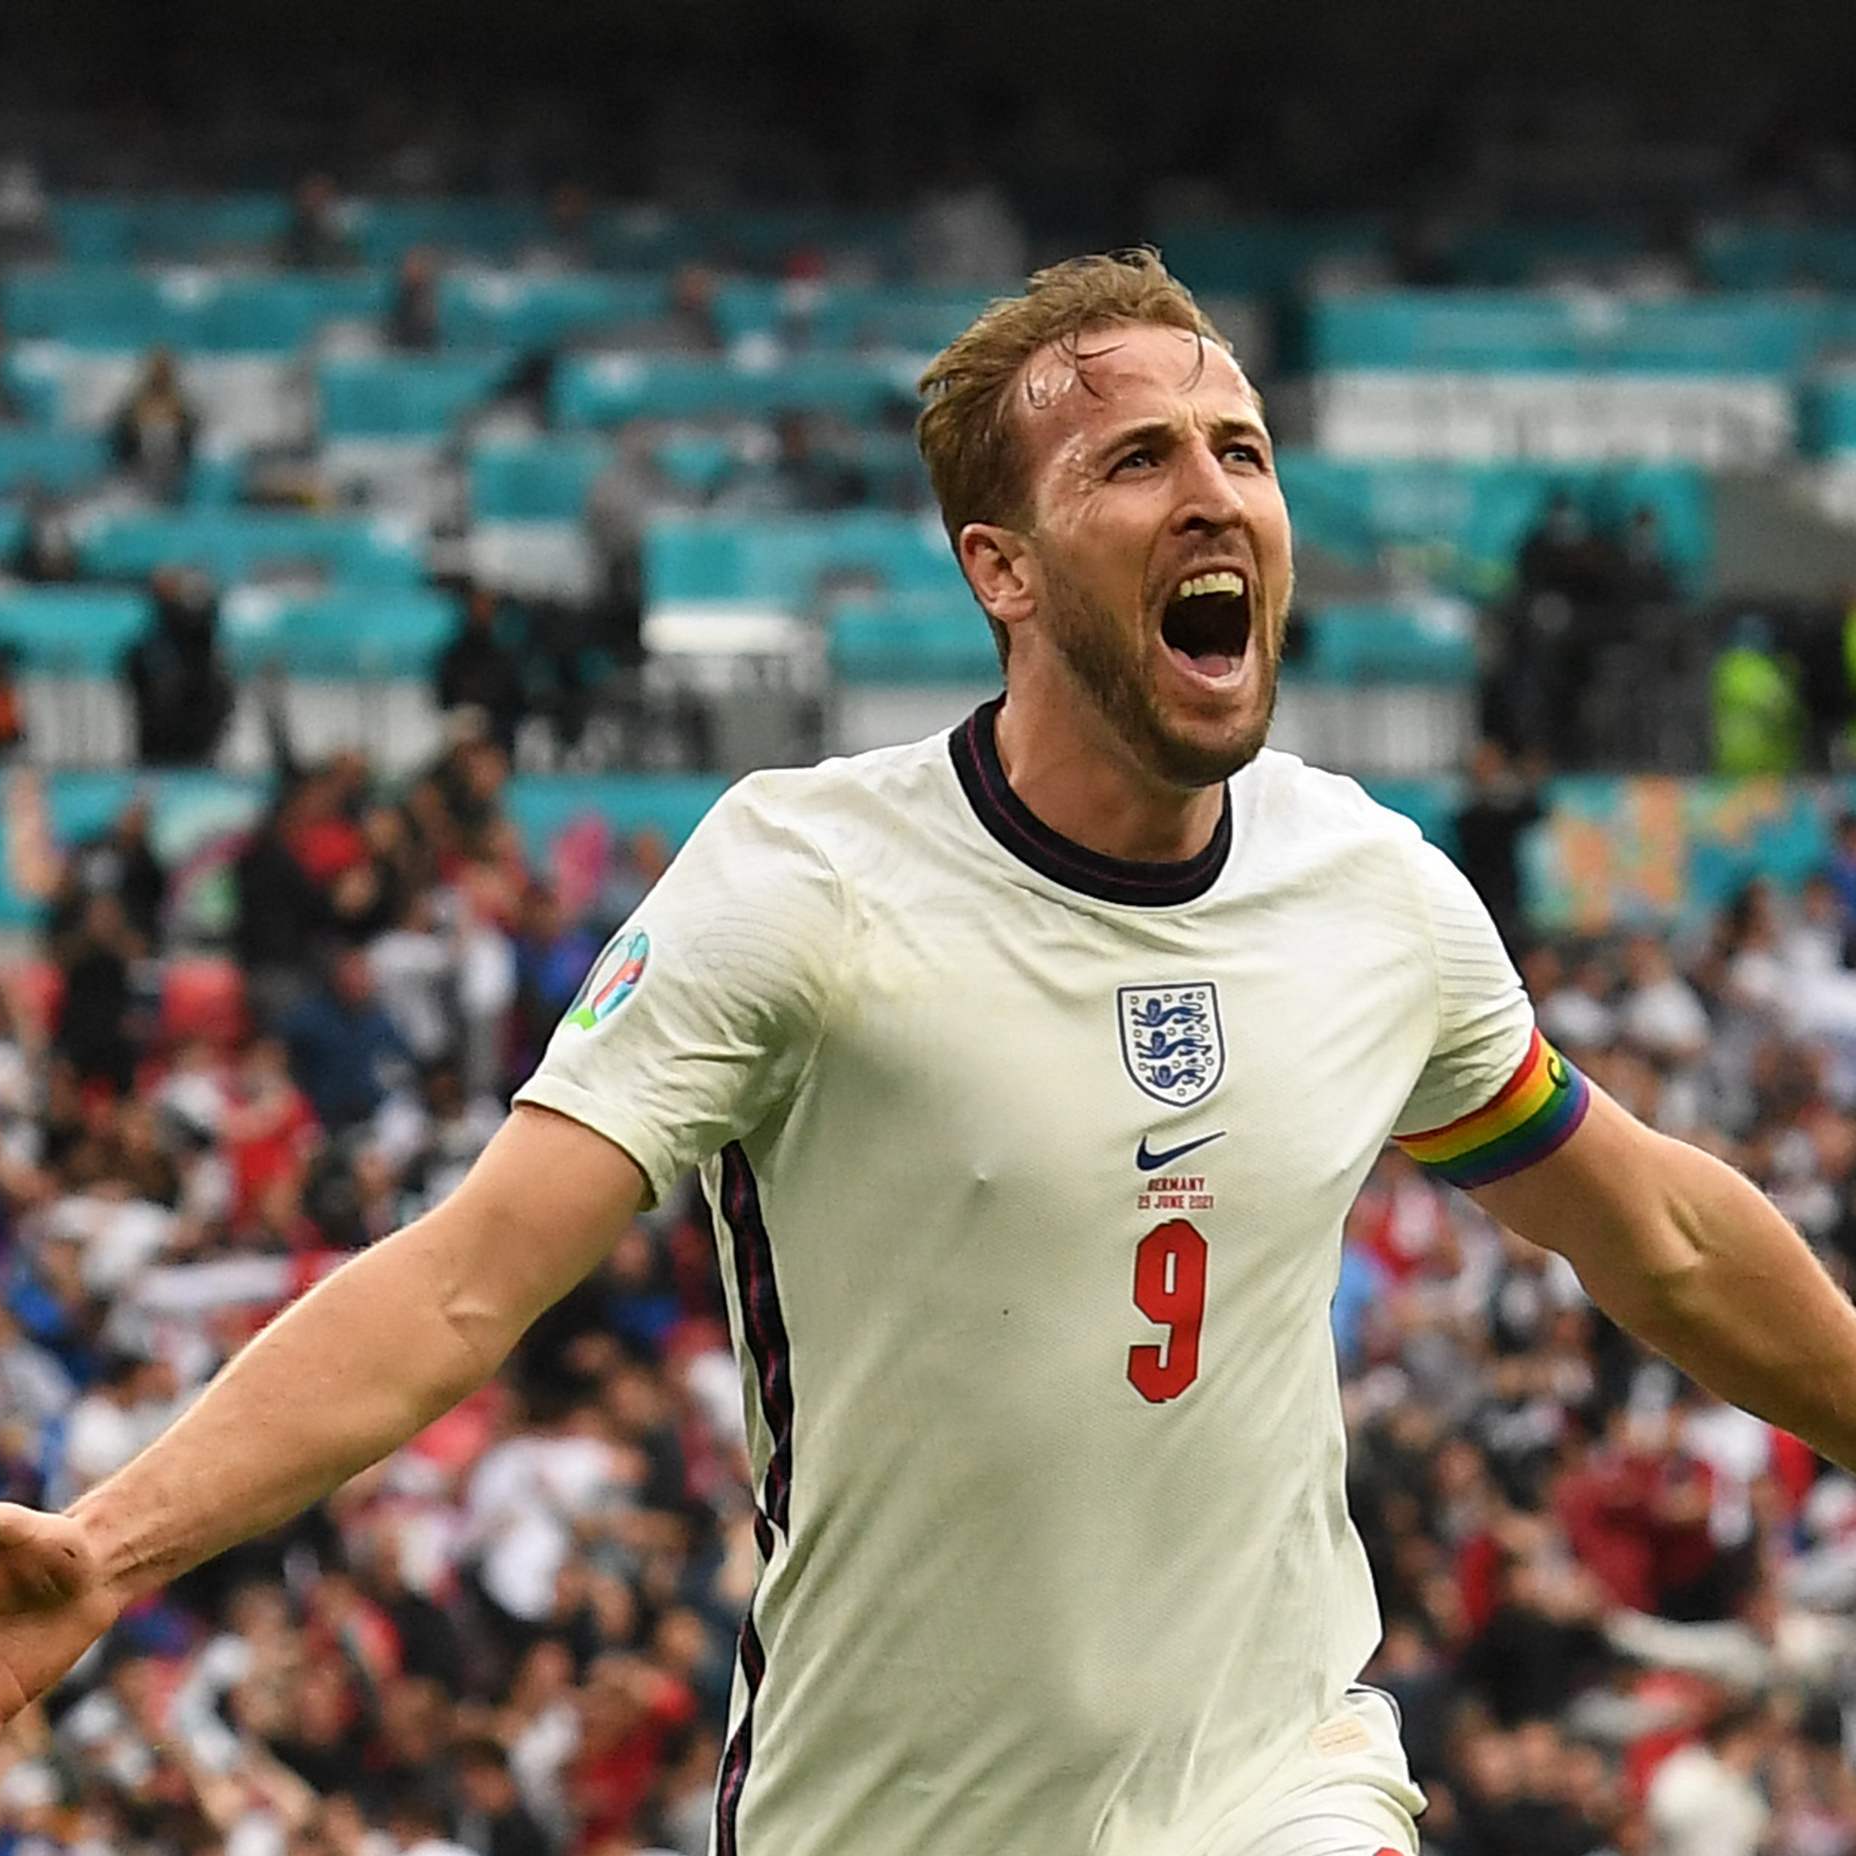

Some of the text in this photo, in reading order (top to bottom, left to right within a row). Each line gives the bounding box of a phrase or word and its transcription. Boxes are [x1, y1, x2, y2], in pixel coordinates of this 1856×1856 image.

[1147, 1176, 1205, 1191] GERMANY
[1154, 1194, 1185, 1210] JUNE
[1127, 1218, 1208, 1404] 9
